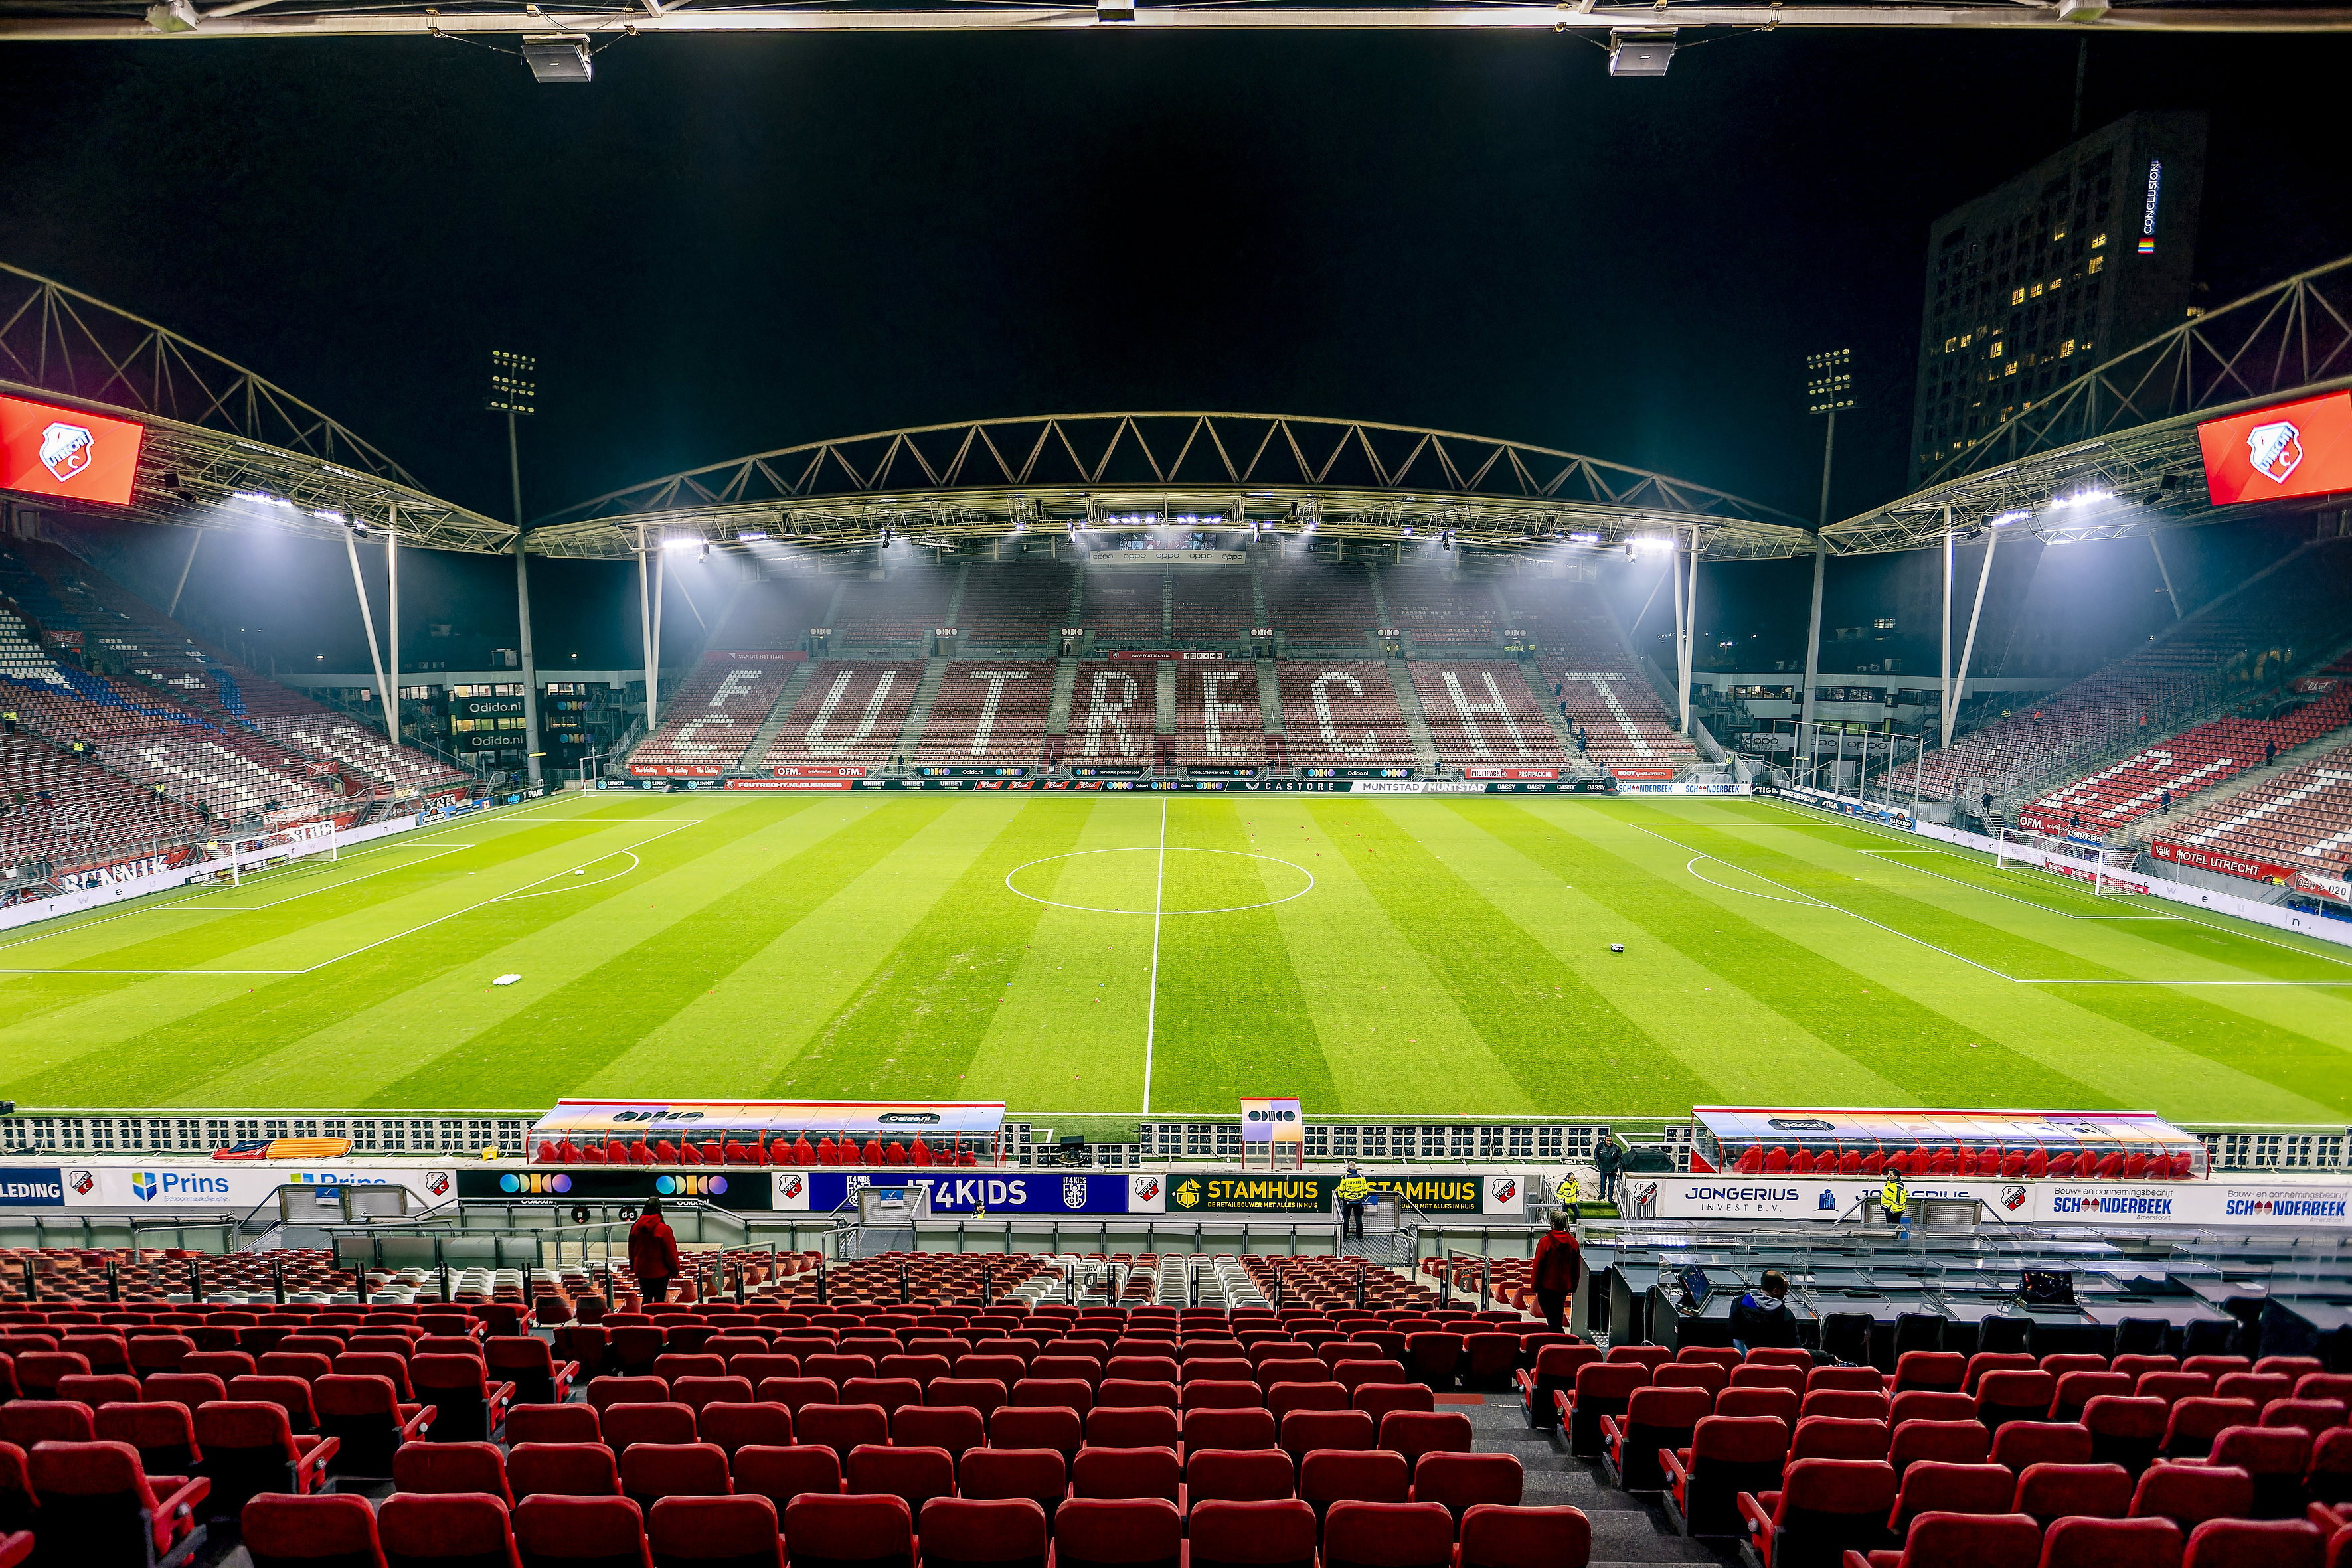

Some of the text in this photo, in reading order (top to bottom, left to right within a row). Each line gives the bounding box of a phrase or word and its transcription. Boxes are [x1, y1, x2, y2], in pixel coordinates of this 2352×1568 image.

[2143, 163, 2159, 234] CONCLUSION
[48, 433, 89, 467] UTRECHT
[68, 455, 80, 468] C
[2279, 452, 2290, 467] C
[469, 702, 521, 713] Odido.nl
[471, 735, 523, 746] Odido.nl
[1847, 741, 1887, 751] oppo
[643, 766, 657, 775] Valley
[673, 766, 689, 775] Valley
[704, 766, 718, 775] Valley
[778, 767, 801, 776] OFM.
[838, 767, 863, 776] OFM.
[1265, 782, 1334, 791] CASTORE
[1428, 783, 1486, 792] MUNTSTAD
[1779, 789, 1818, 803] TUINGEREEDSCHAP
[1821, 800, 1839, 809] STIGA
[2019, 815, 2045, 830] OFM.
[2155, 845, 2260, 876] Valk HOTEL UTRECHT
[2297, 878, 2347, 896] 030 020
[82, 1182, 90, 1191] C
[162, 1173, 230, 1192] Prins
[782, 1176, 801, 1194] UTRECHT
[1138, 1178, 1159, 1197] UTRECHT
[1207, 1180, 1319, 1199] STAMHUIS
[1495, 1180, 1515, 1199] UTRECHT
[1637, 1182, 1658, 1202] UTRECHT
[1685, 1188, 1800, 1200] JONGERIUS
[2095, 1187, 2175, 1197] aannemingsbedrijf
[2268, 1190, 2349, 1200] aannemingsbedrijf
[2003, 1187, 2025, 1206] UTRECHT
